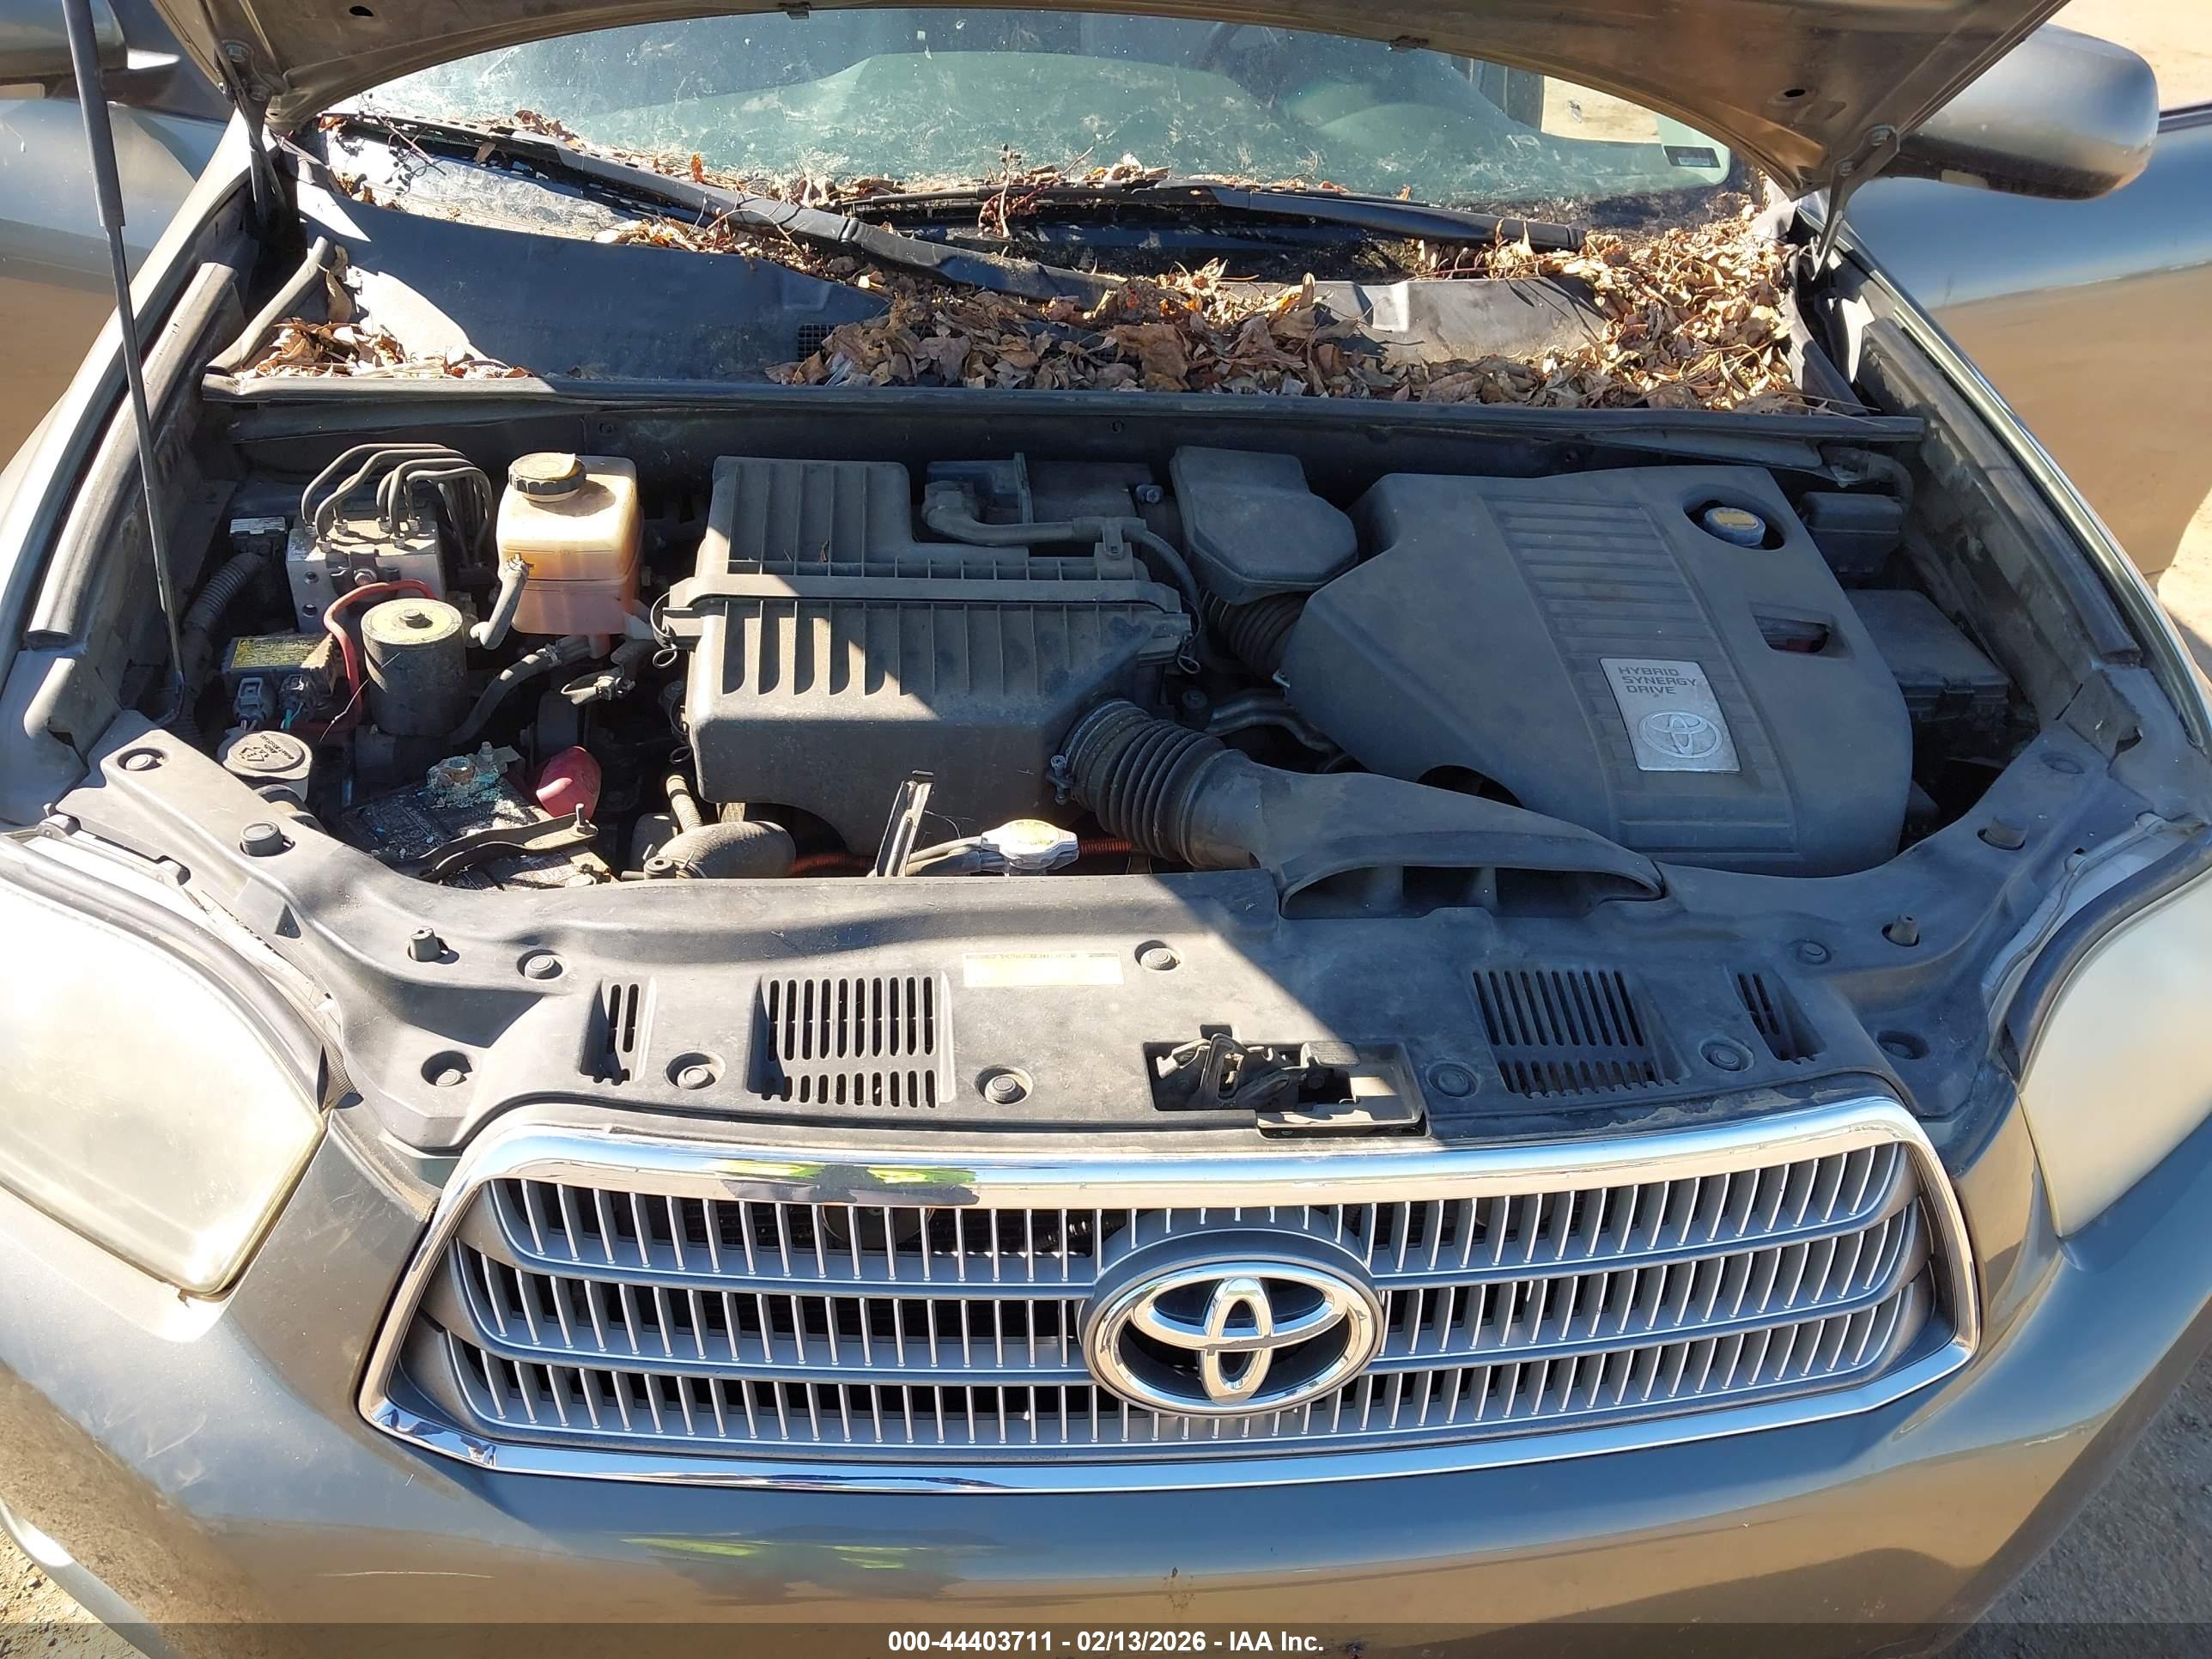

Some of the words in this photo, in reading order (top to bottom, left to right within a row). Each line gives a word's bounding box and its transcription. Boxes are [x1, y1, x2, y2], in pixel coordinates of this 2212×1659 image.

[1618, 667, 1680, 676] HYBRID
[1622, 677, 1697, 686] SYNERGY
[1627, 685, 1676, 694] DRIVE
